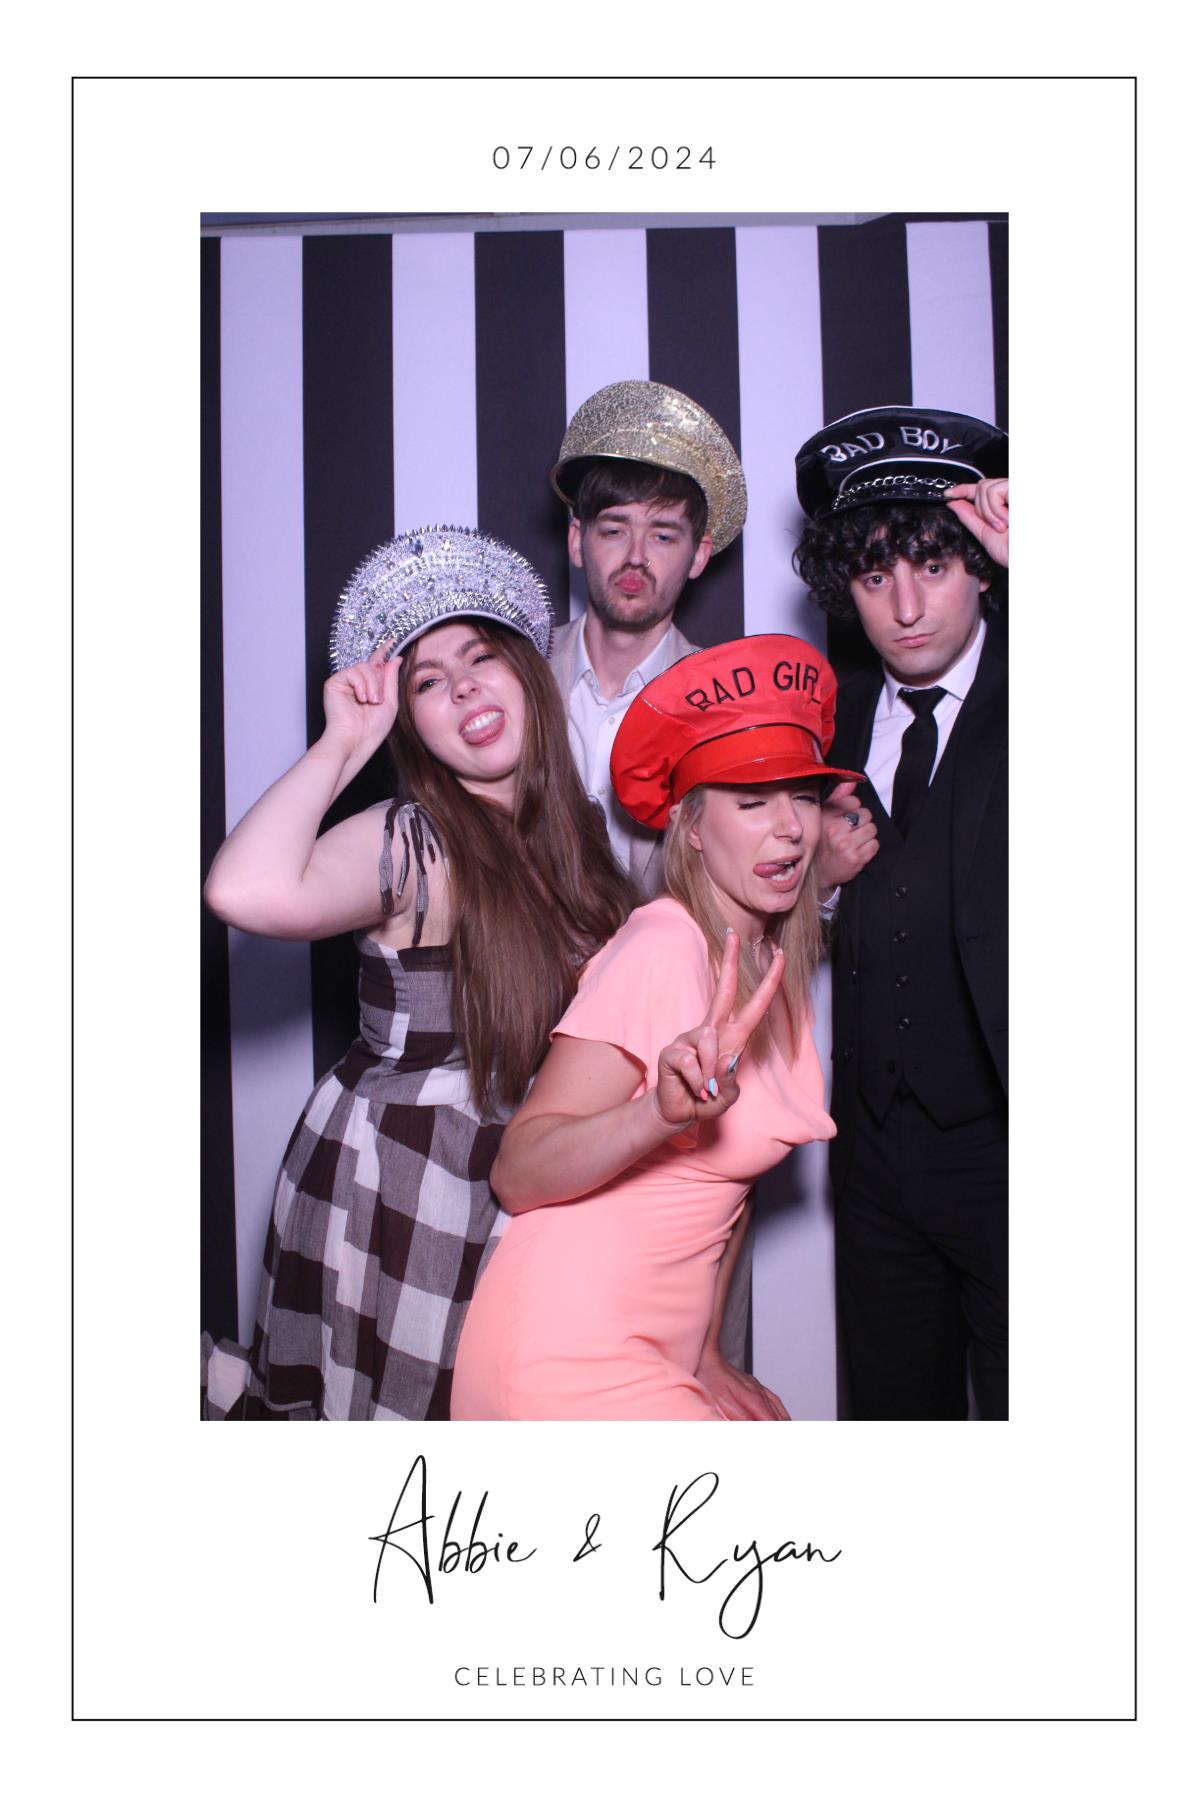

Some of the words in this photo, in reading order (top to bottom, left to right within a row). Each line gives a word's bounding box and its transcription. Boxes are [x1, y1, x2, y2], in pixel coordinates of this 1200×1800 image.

[820, 432, 886, 462] BAD
[899, 425, 964, 454] BOY
[684, 666, 756, 712] BAD
